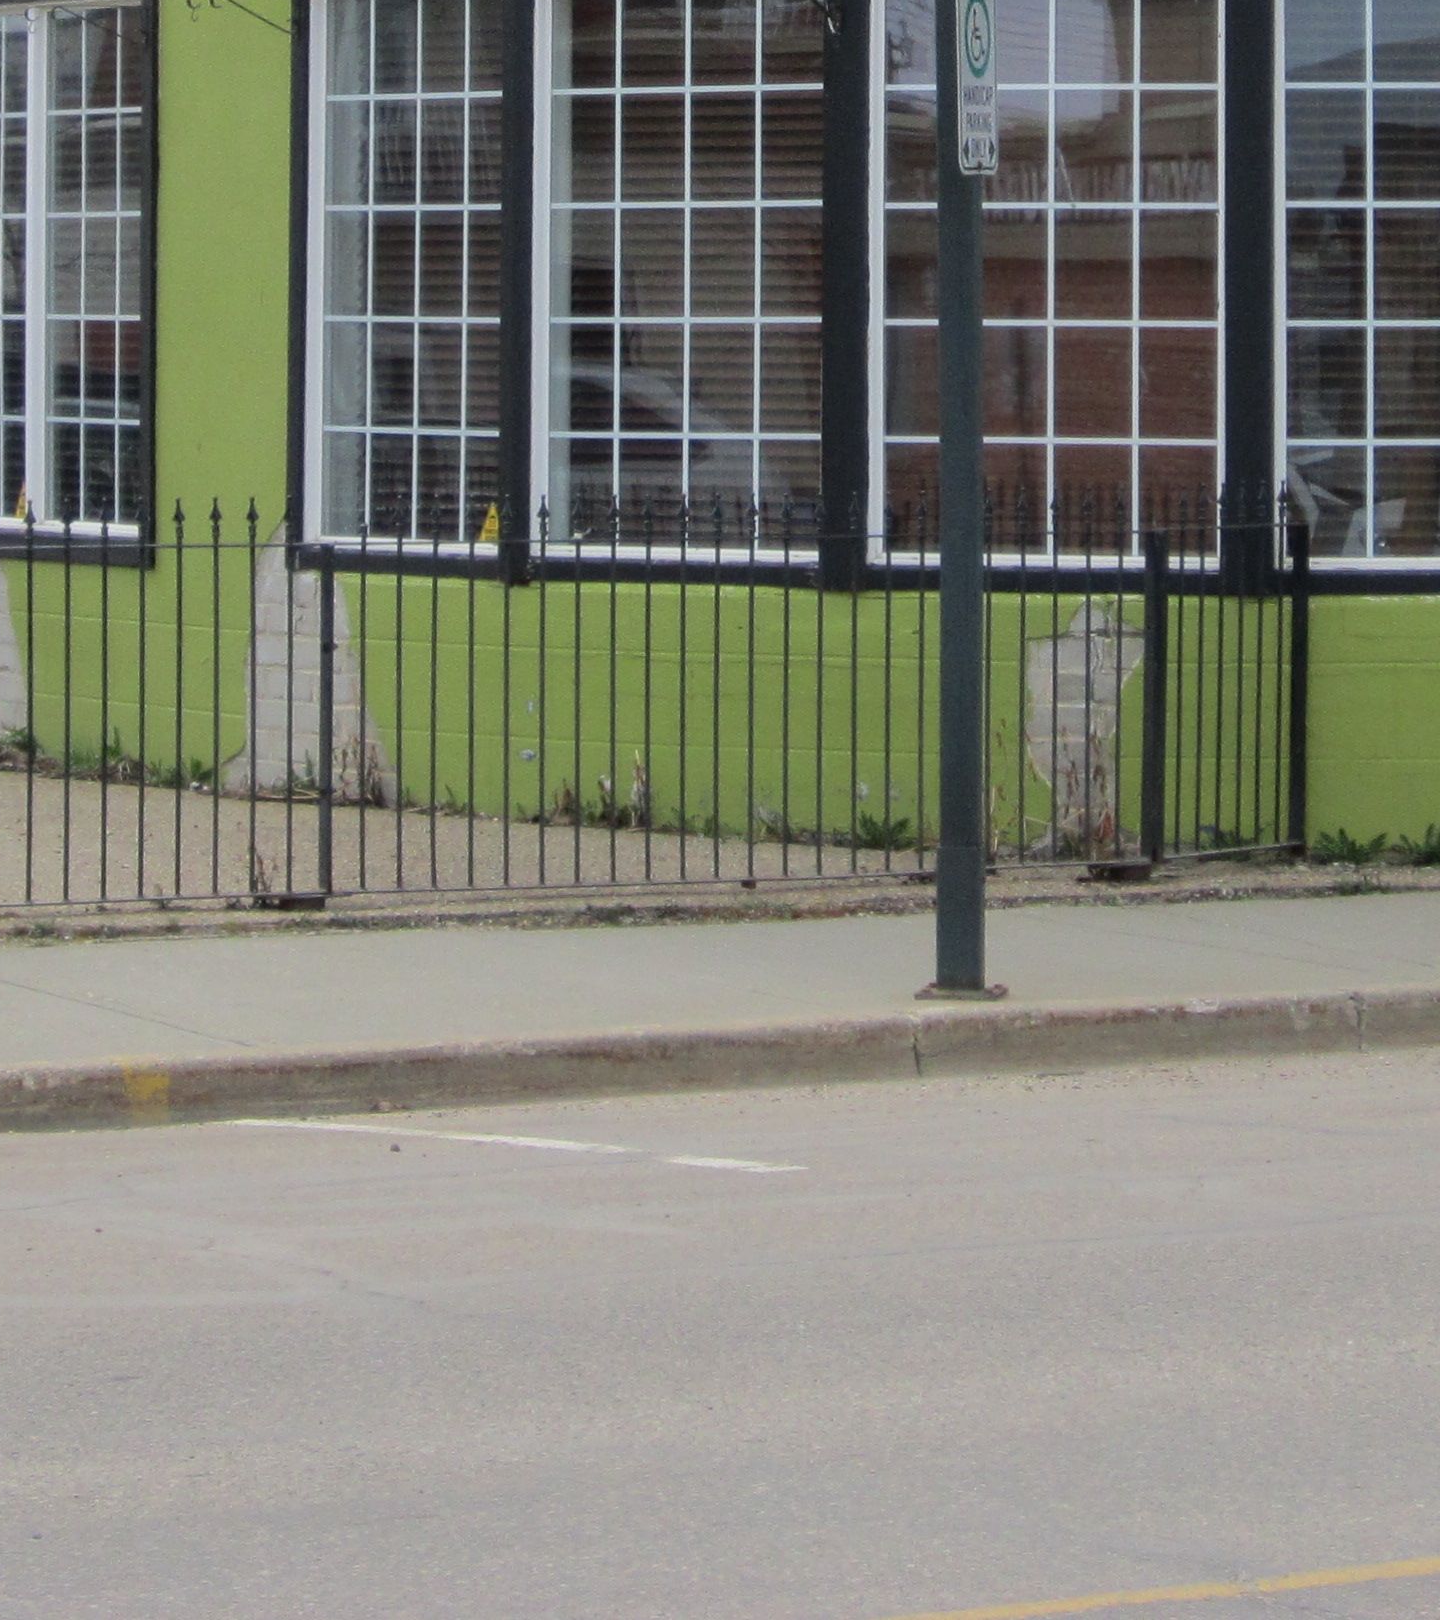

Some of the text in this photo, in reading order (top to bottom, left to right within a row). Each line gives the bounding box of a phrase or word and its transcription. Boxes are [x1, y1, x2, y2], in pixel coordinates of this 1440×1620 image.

[963, 85, 994, 106] HANDICAP
[965, 112, 993, 132] PARKING
[970, 138, 987, 158] ONLY
